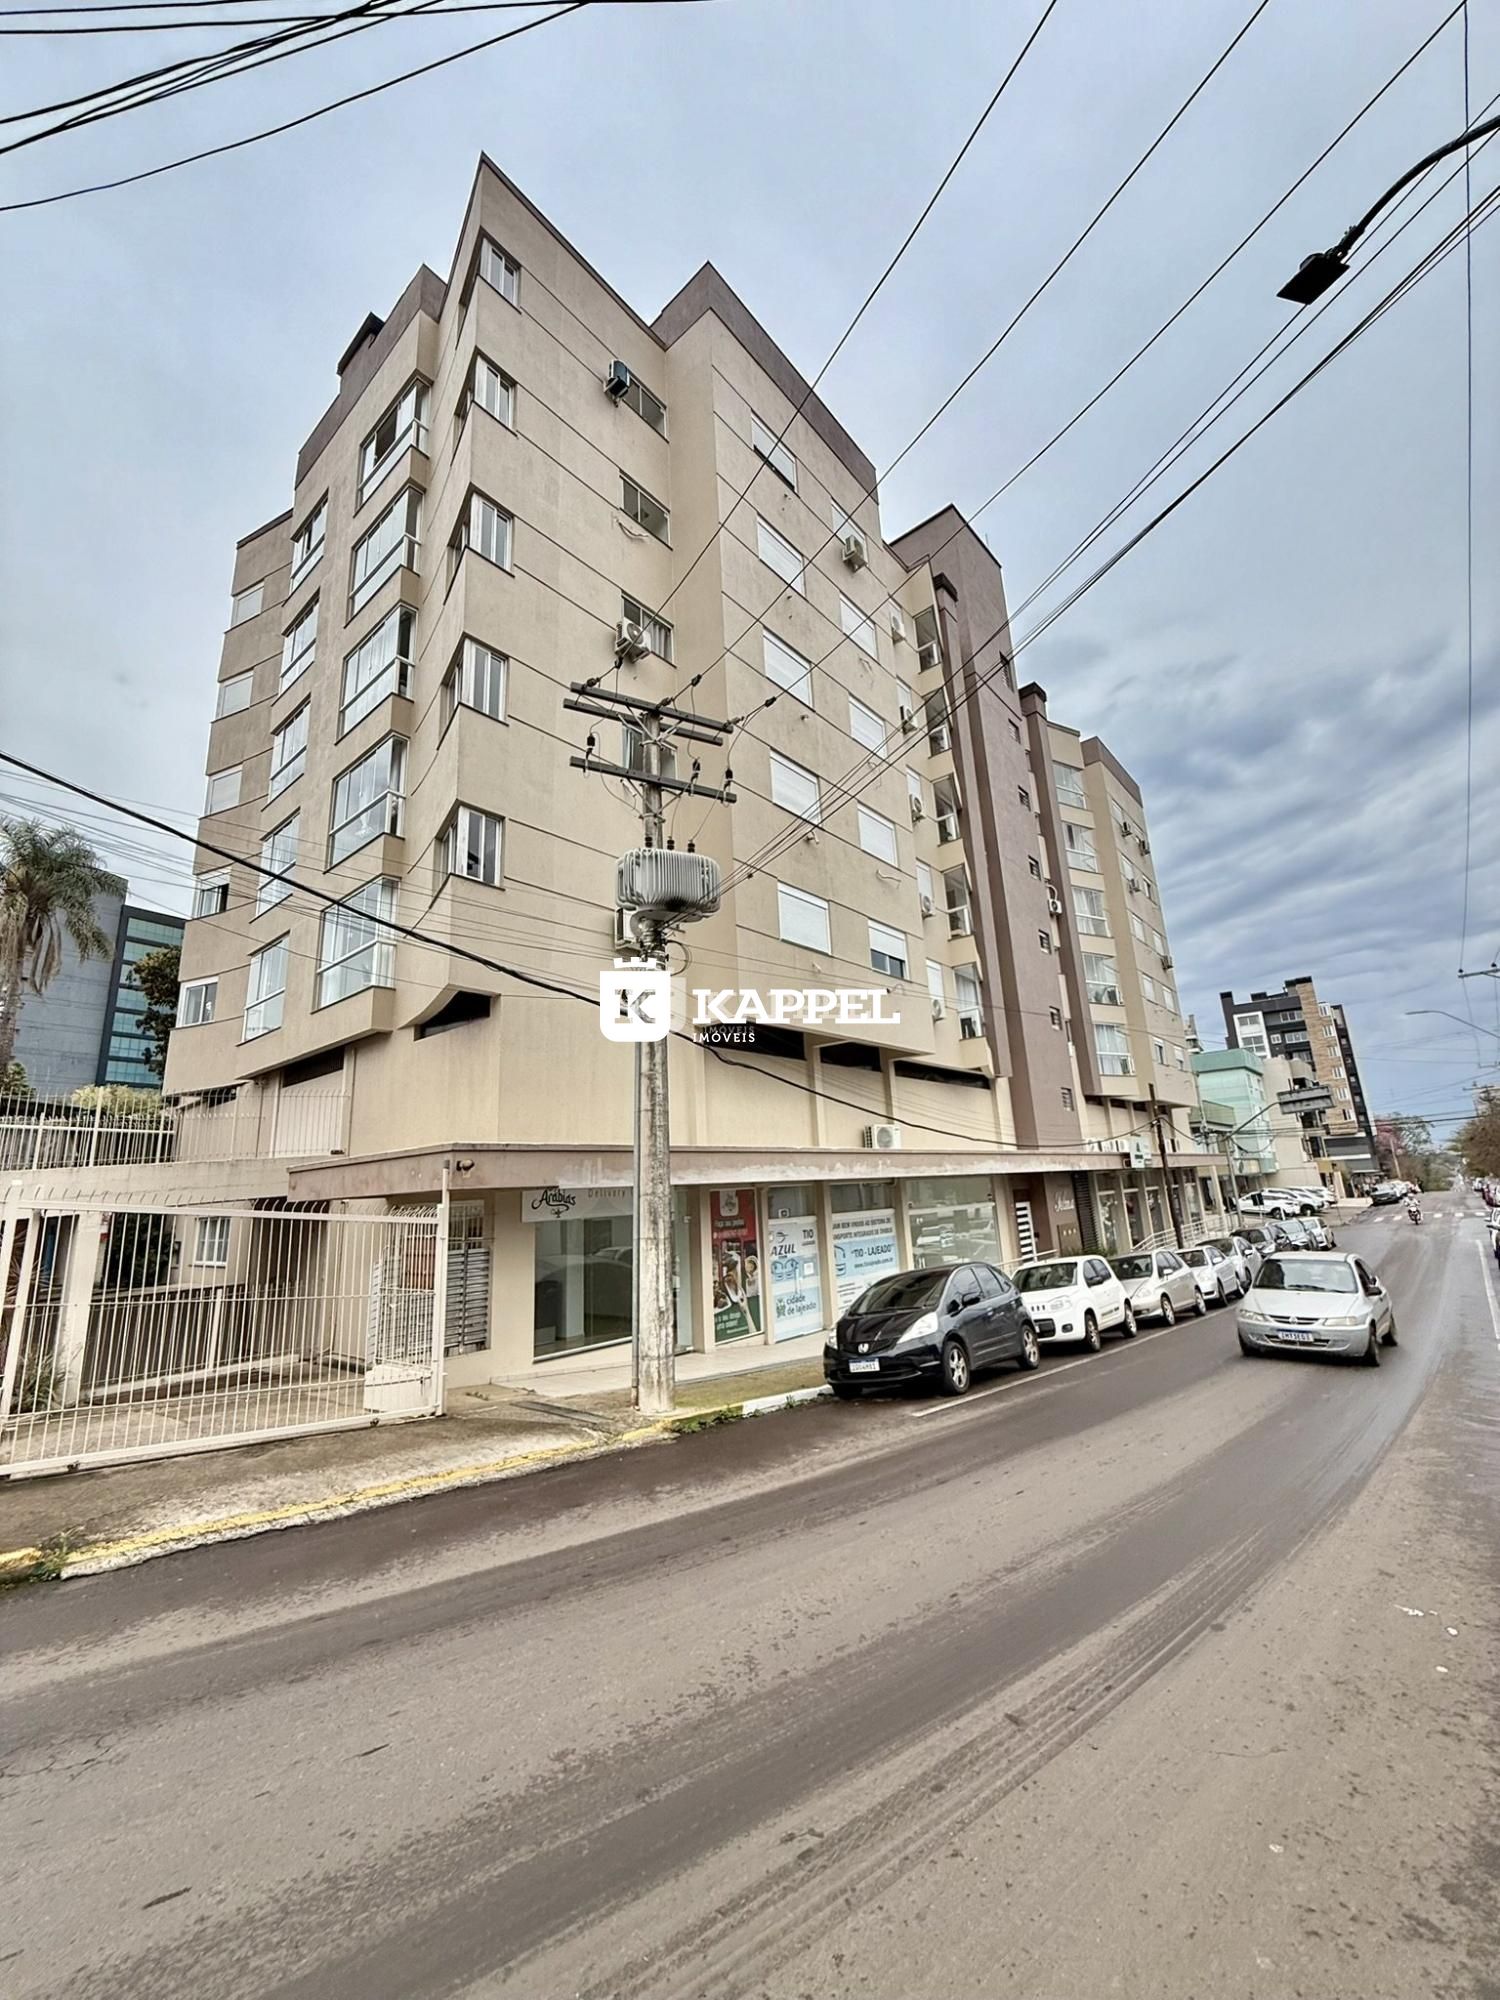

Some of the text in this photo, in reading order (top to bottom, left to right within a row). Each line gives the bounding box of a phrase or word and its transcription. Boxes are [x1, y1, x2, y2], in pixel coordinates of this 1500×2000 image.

[802, 1229, 814, 1239] TIO
[771, 1244, 796, 1256] AZUL
[786, 1295, 806, 1305] cidade
[787, 1302, 817, 1316] de lajeado
